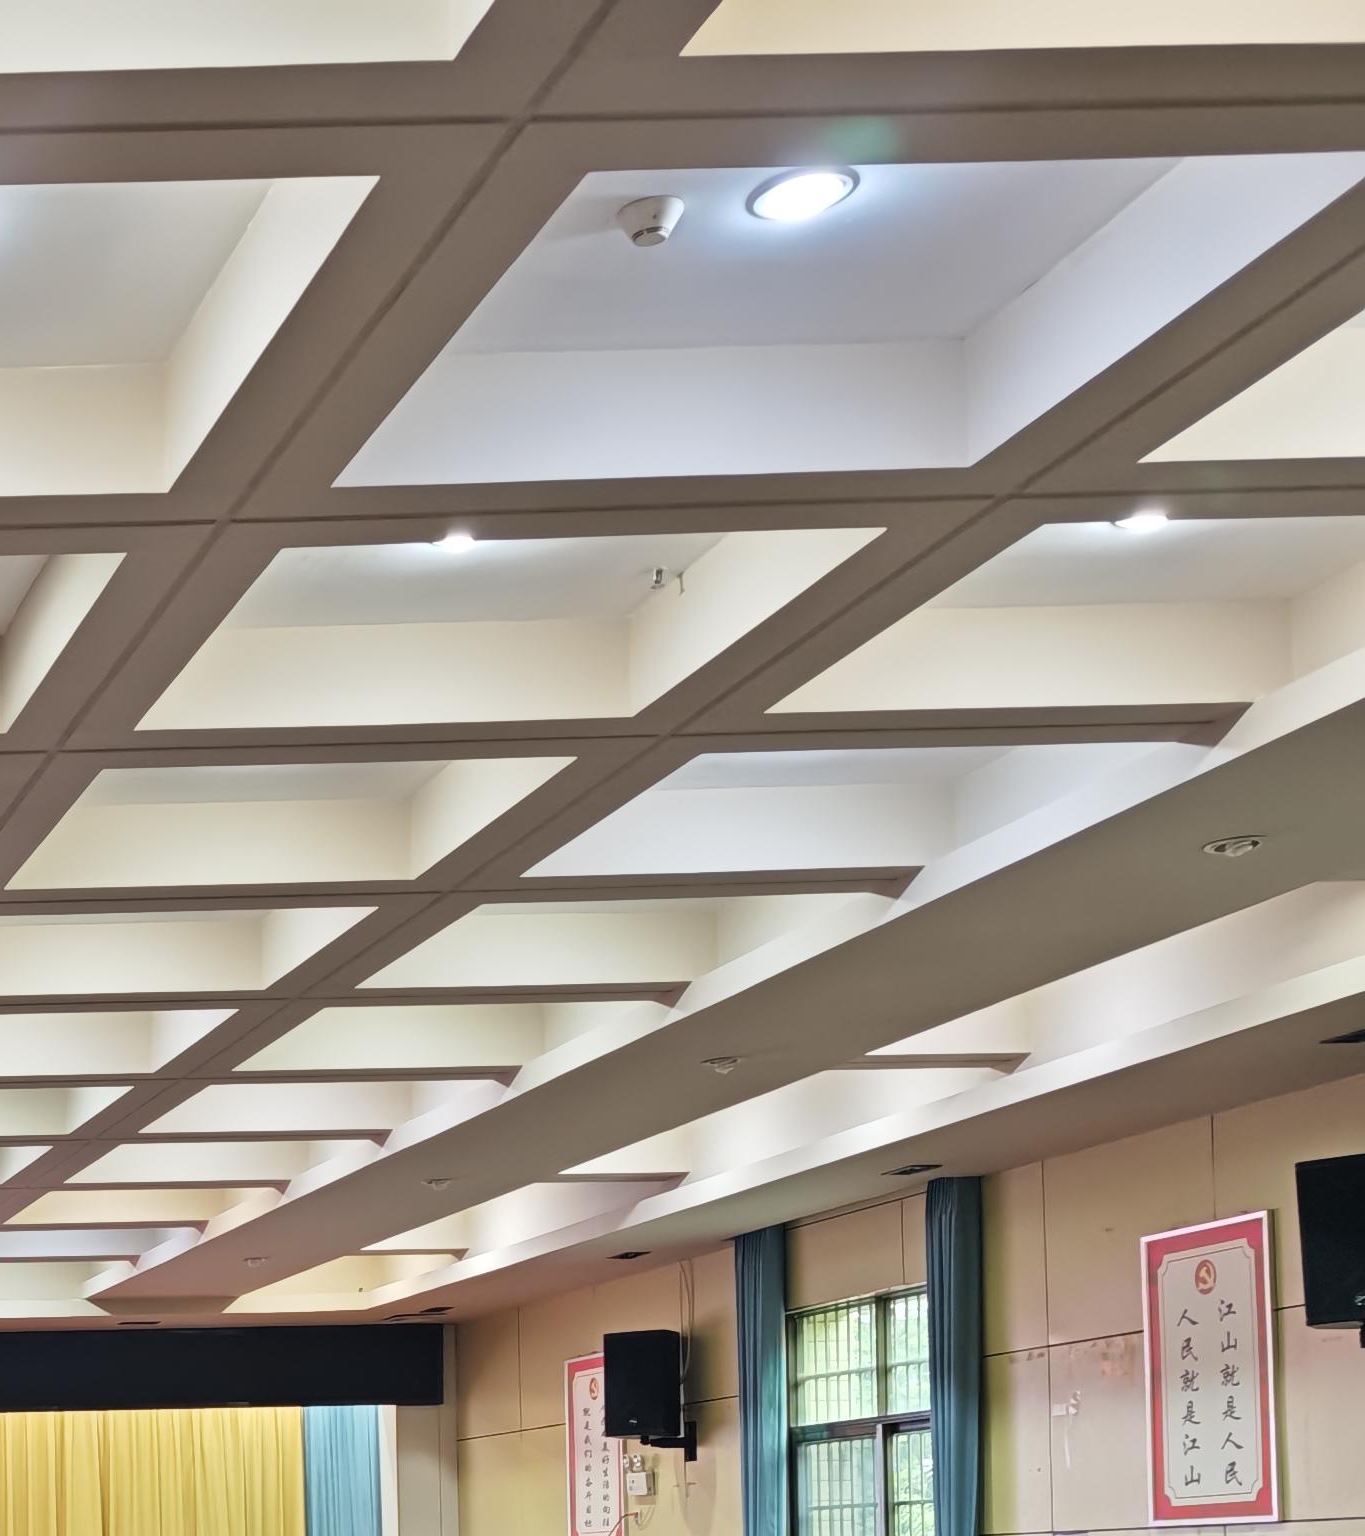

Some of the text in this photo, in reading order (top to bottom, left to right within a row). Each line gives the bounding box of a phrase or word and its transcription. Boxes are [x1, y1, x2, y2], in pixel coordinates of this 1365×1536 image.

[1177, 1309, 1201, 1486] 人民就是江山
[1218, 1299, 1244, 1486] 江山就是人民
